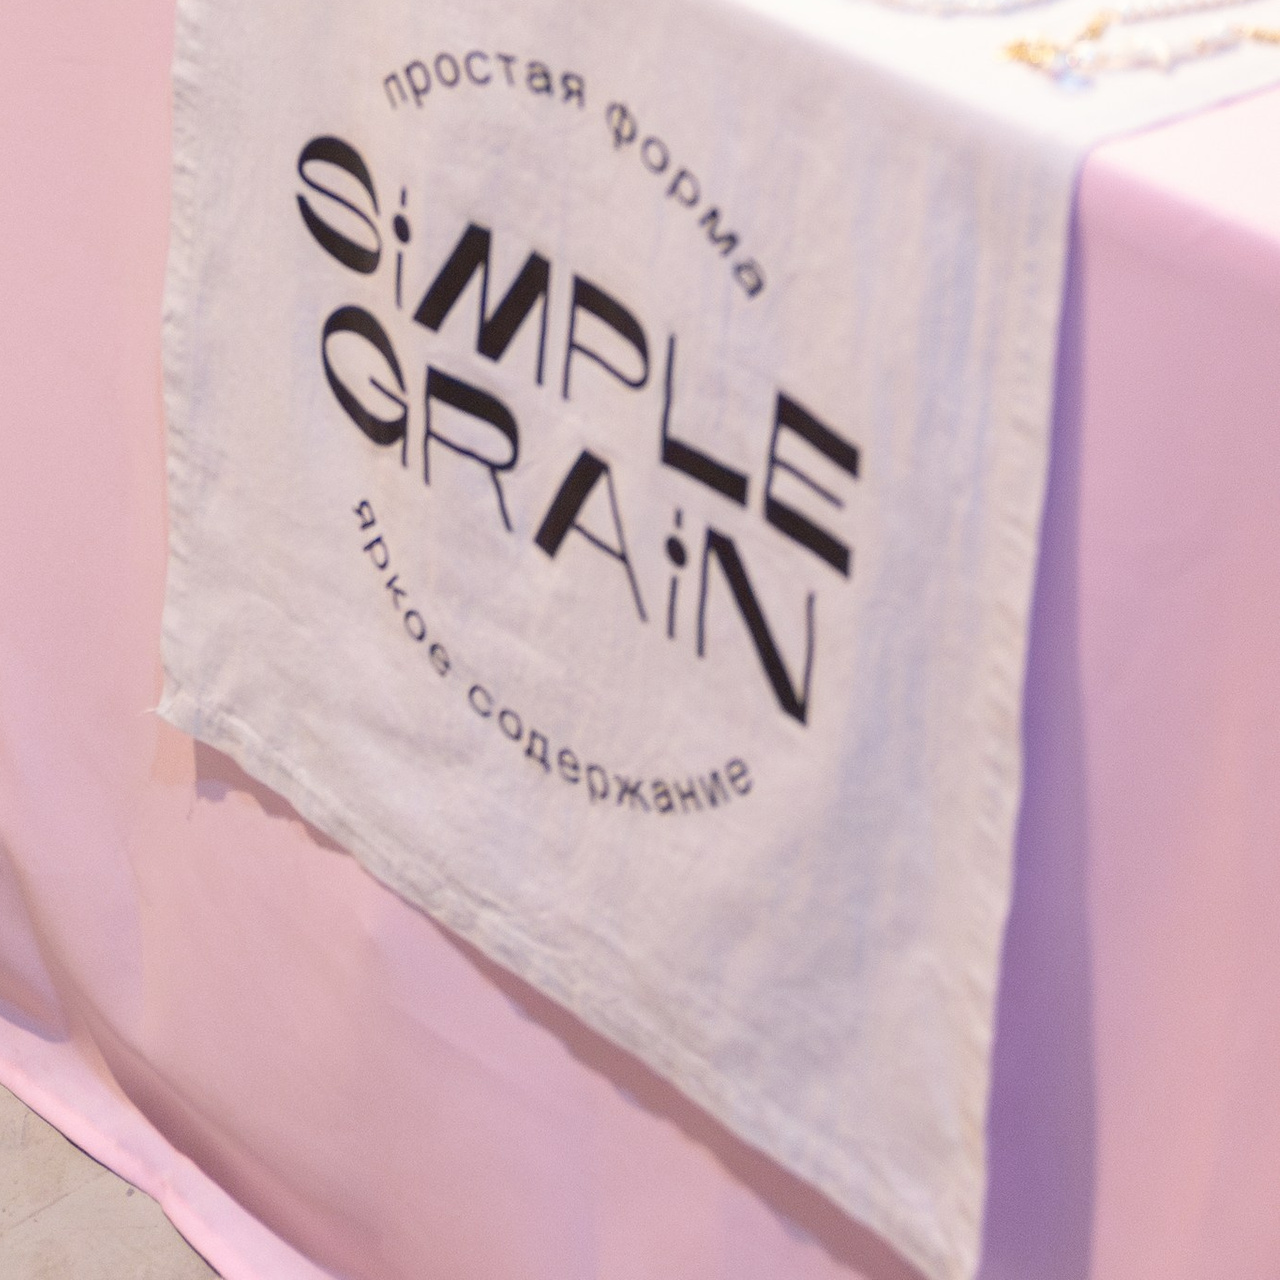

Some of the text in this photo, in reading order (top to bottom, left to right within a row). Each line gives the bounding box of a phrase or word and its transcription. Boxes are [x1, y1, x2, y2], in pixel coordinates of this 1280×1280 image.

[382, 49, 767, 300] простая форма
[352, 499, 754, 815] яркое содержание
